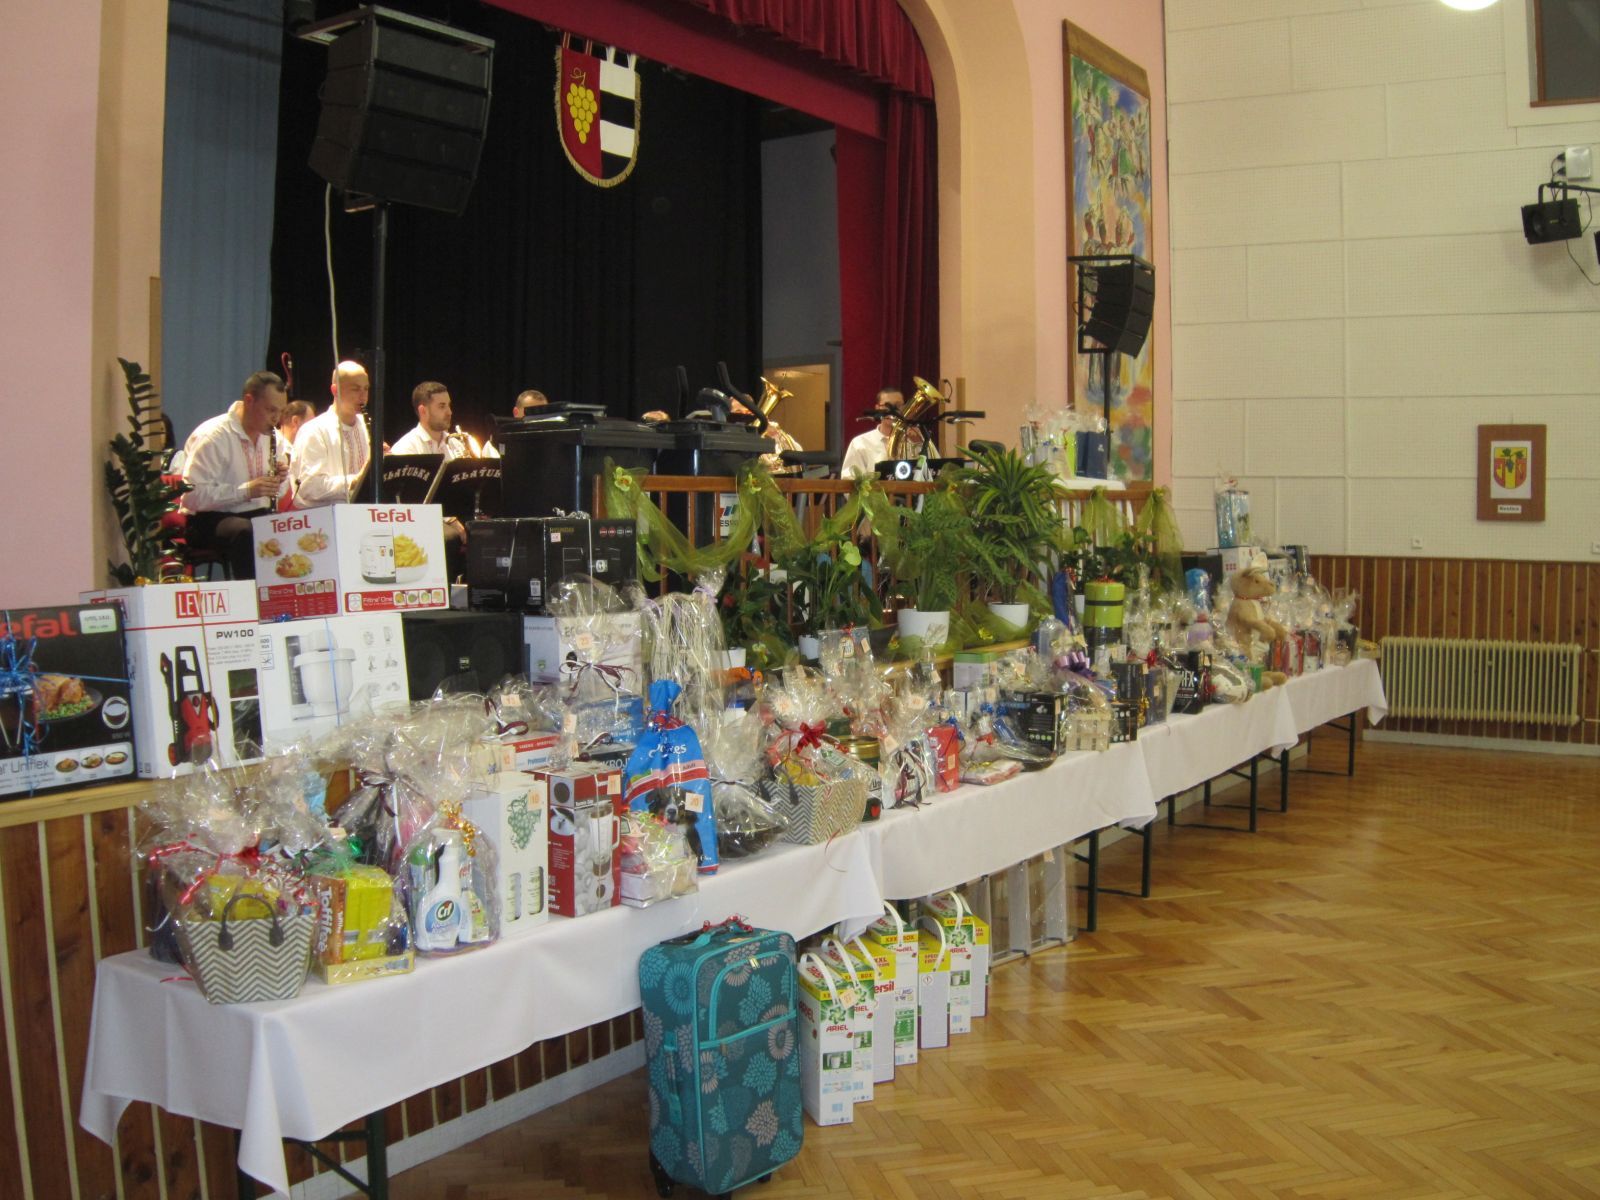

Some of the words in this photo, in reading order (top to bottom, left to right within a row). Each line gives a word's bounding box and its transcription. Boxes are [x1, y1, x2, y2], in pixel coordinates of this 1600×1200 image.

[270, 515, 311, 533] Tefal
[368, 508, 415, 523] Tefal
[178, 592, 227, 617] LEVITA
[216, 629, 254, 639] PW100
[11, 757, 49, 774] Unflex
[437, 902, 453, 919] Cif
[318, 887, 333, 952] Toffifee
[874, 981, 895, 994] ersil
[826, 1024, 848, 1033] ARIEL
